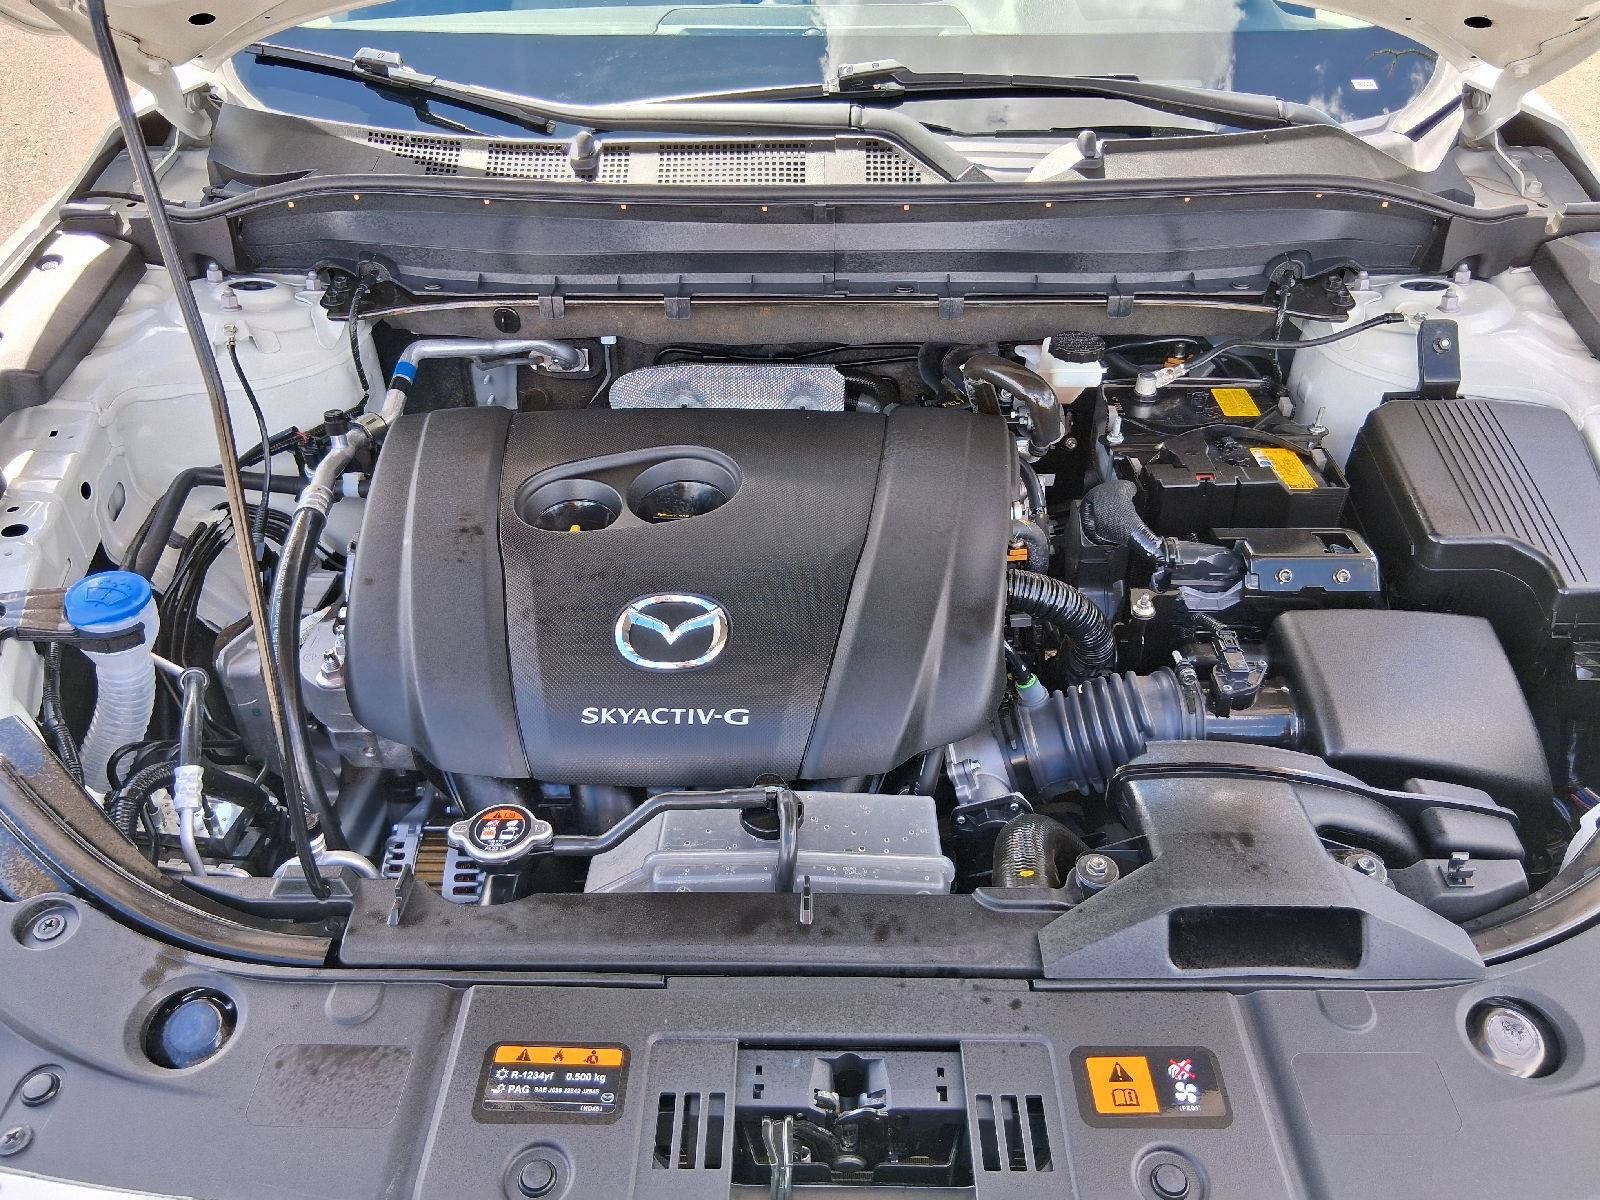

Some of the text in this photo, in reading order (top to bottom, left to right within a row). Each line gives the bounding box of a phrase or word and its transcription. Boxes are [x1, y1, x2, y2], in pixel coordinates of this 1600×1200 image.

[581, 707, 750, 725] SKYACTIV-G
[511, 1071, 607, 1084] R-1234yf 0.500 kg
[507, 1085, 530, 1094] PAG
